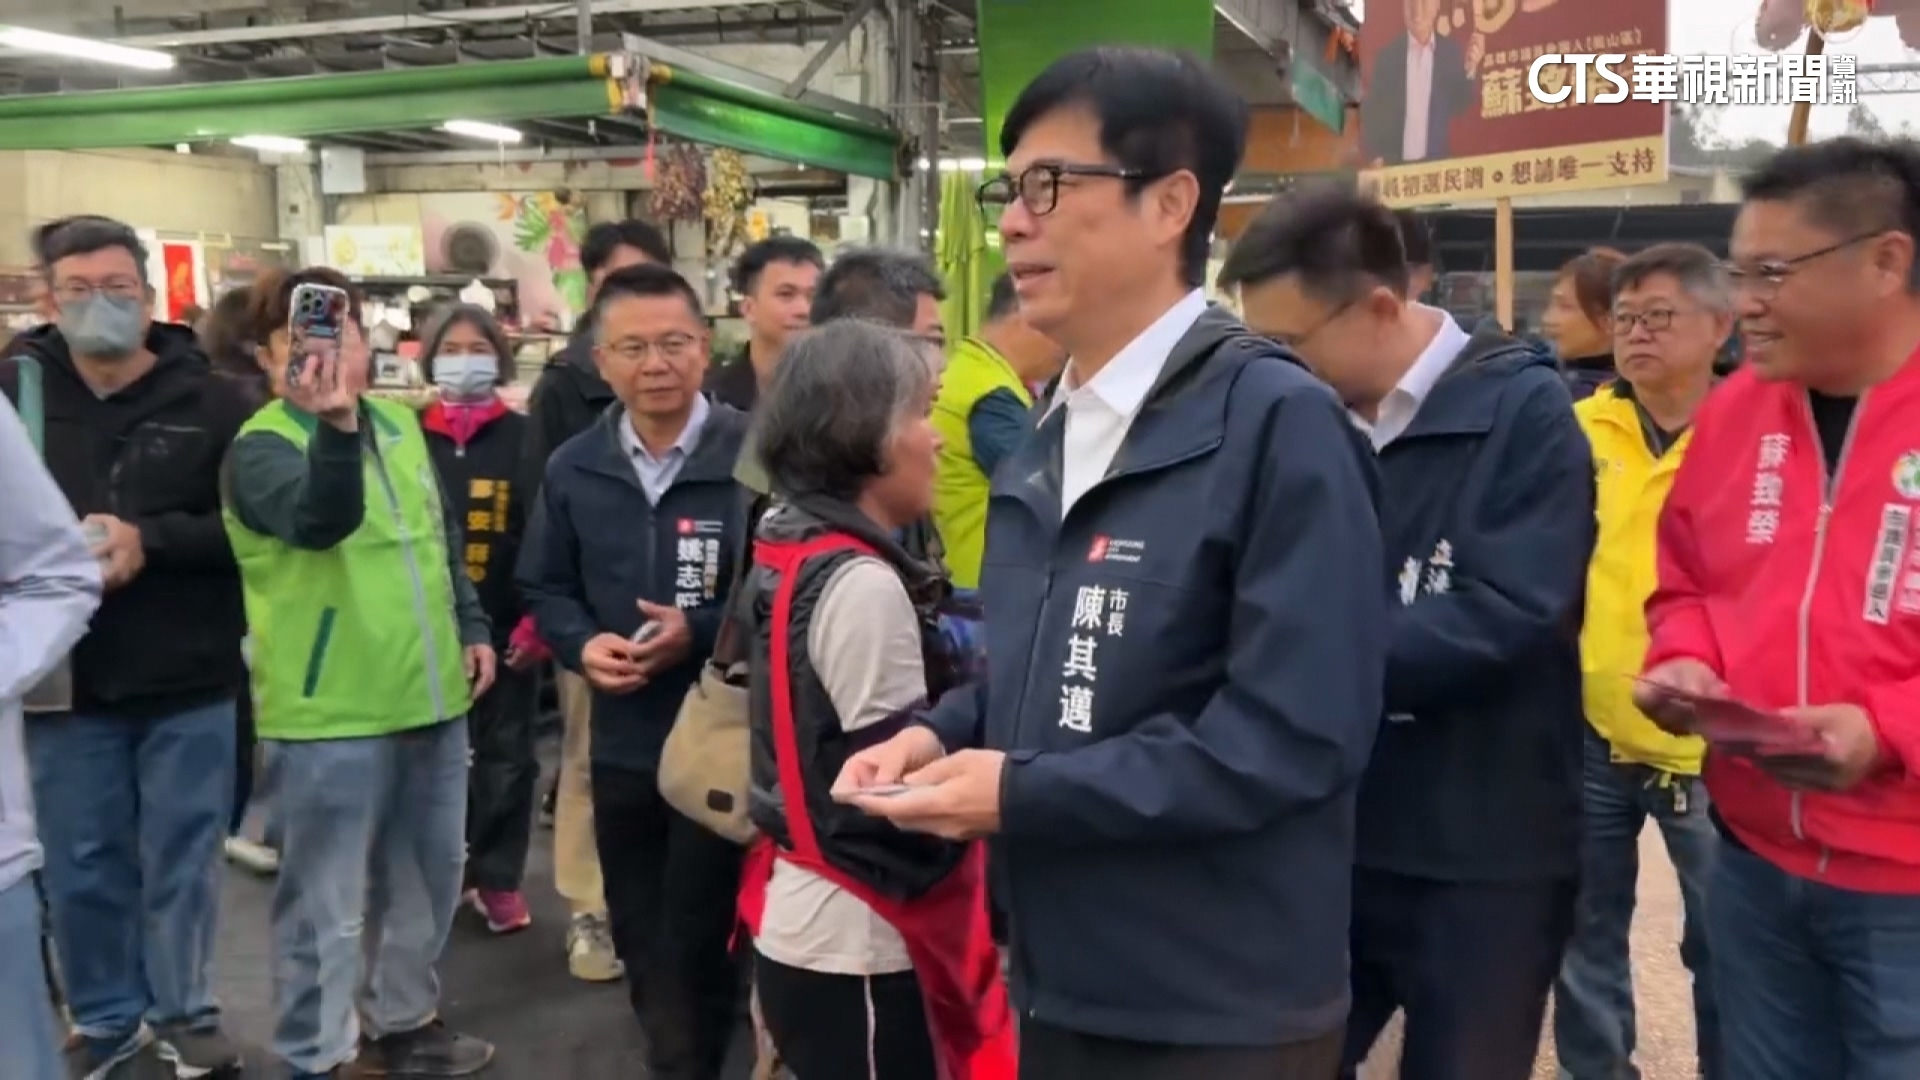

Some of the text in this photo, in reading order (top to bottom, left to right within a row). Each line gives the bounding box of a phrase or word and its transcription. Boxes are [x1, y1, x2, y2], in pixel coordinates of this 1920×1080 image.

[1058, 584, 1106, 733] 陳其邁
[1106, 588, 1130, 637] 市長
